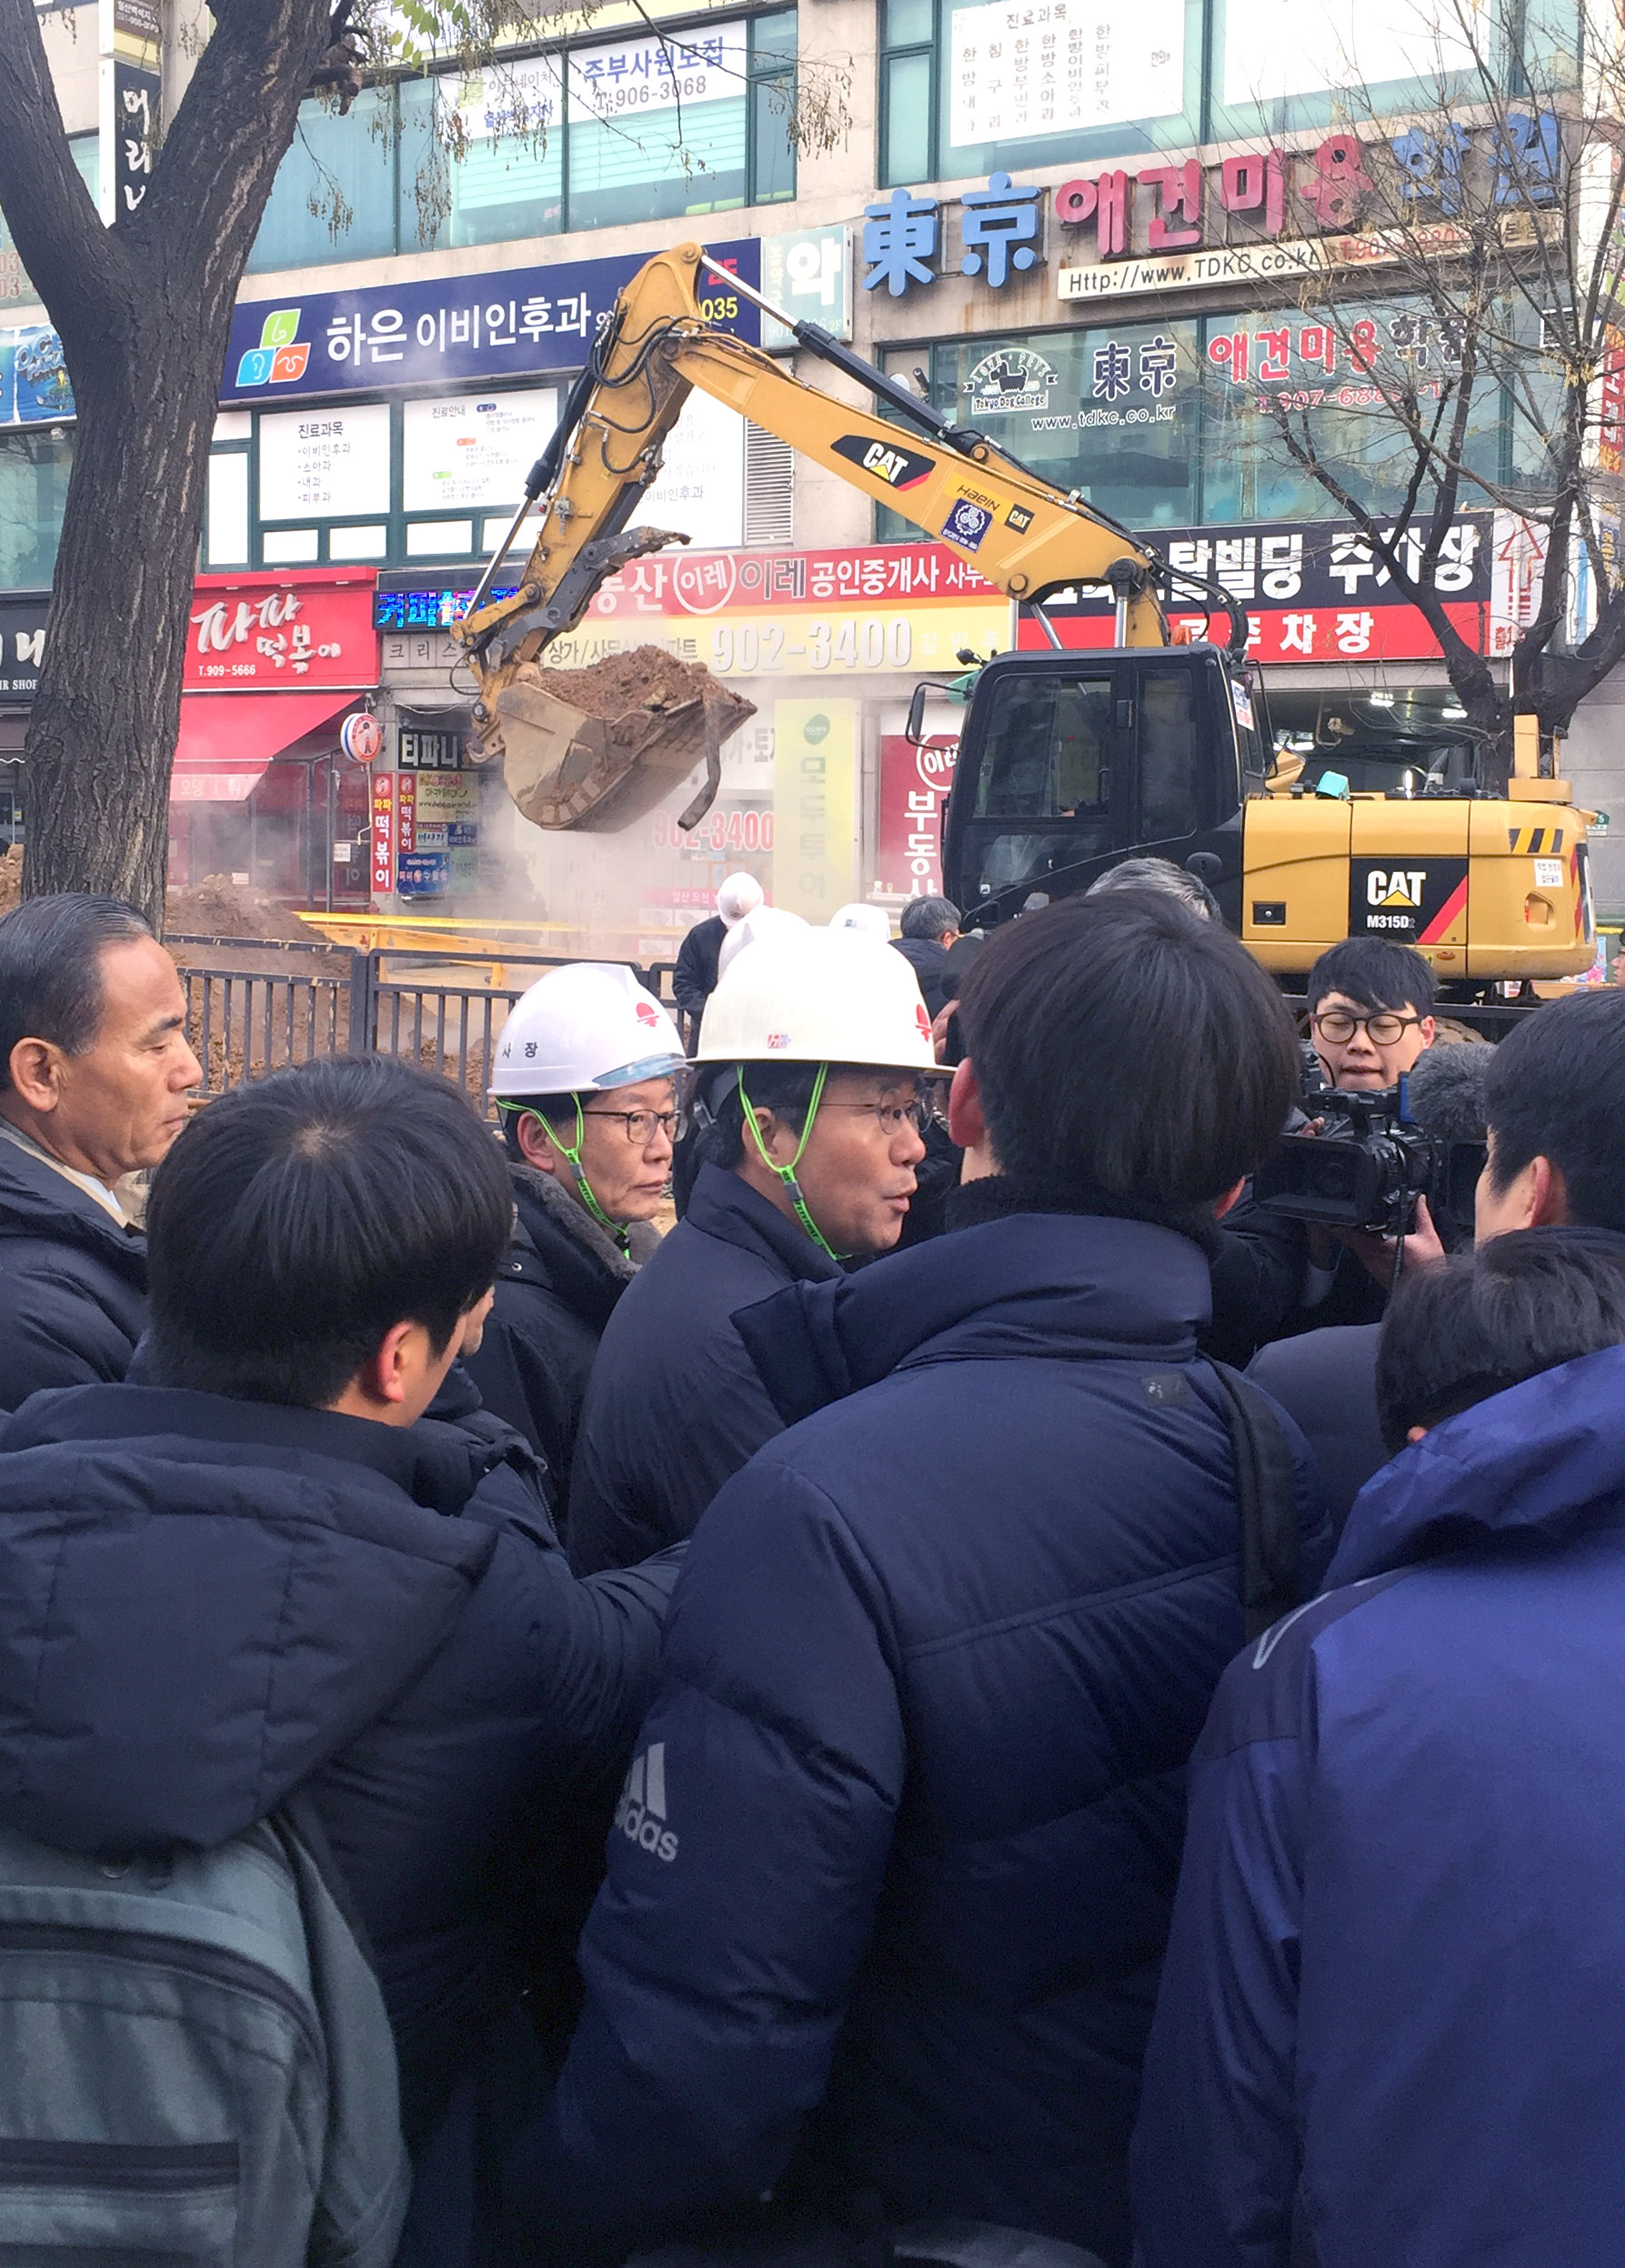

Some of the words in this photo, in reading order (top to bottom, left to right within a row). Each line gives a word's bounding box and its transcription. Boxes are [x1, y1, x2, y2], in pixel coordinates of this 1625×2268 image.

[1007, 3, 1068, 30] 진료과목
[585, 36, 724, 84] 주부사원모집
[862, 171, 1042, 296] 東京
[326, 309, 407, 366] 하은
[416, 292, 591, 352] 이비인후과
[298, 421, 344, 439] 진료과목
[432, 406, 466, 418] 진료안내
[1031, 404, 1176, 431] www.tdkc.co.kr
[302, 442, 351, 457] 이비인후과
[863, 442, 908, 483] CAT
[303, 492, 331, 504] 피부과
[1008, 510, 1030, 528] CAT
[597, 564, 667, 614] 동산
[681, 559, 727, 596] 이레
[740, 557, 807, 600] 이레
[810, 555, 940, 598] 공인중개사
[946, 561, 995, 589] 사무
[256, 624, 342, 675] 떡볶이
[389, 640, 456, 660] 크리스
[711, 617, 912, 672] 902-3400
[198, 664, 256, 677] T.909-5666
[401, 733, 458, 768] 티파니
[401, 806, 412, 850] 떡볶이
[654, 810, 775, 852] 902-3400
[375, 815, 390, 888] 떡볶이
[1367, 870, 1426, 907] CAT
